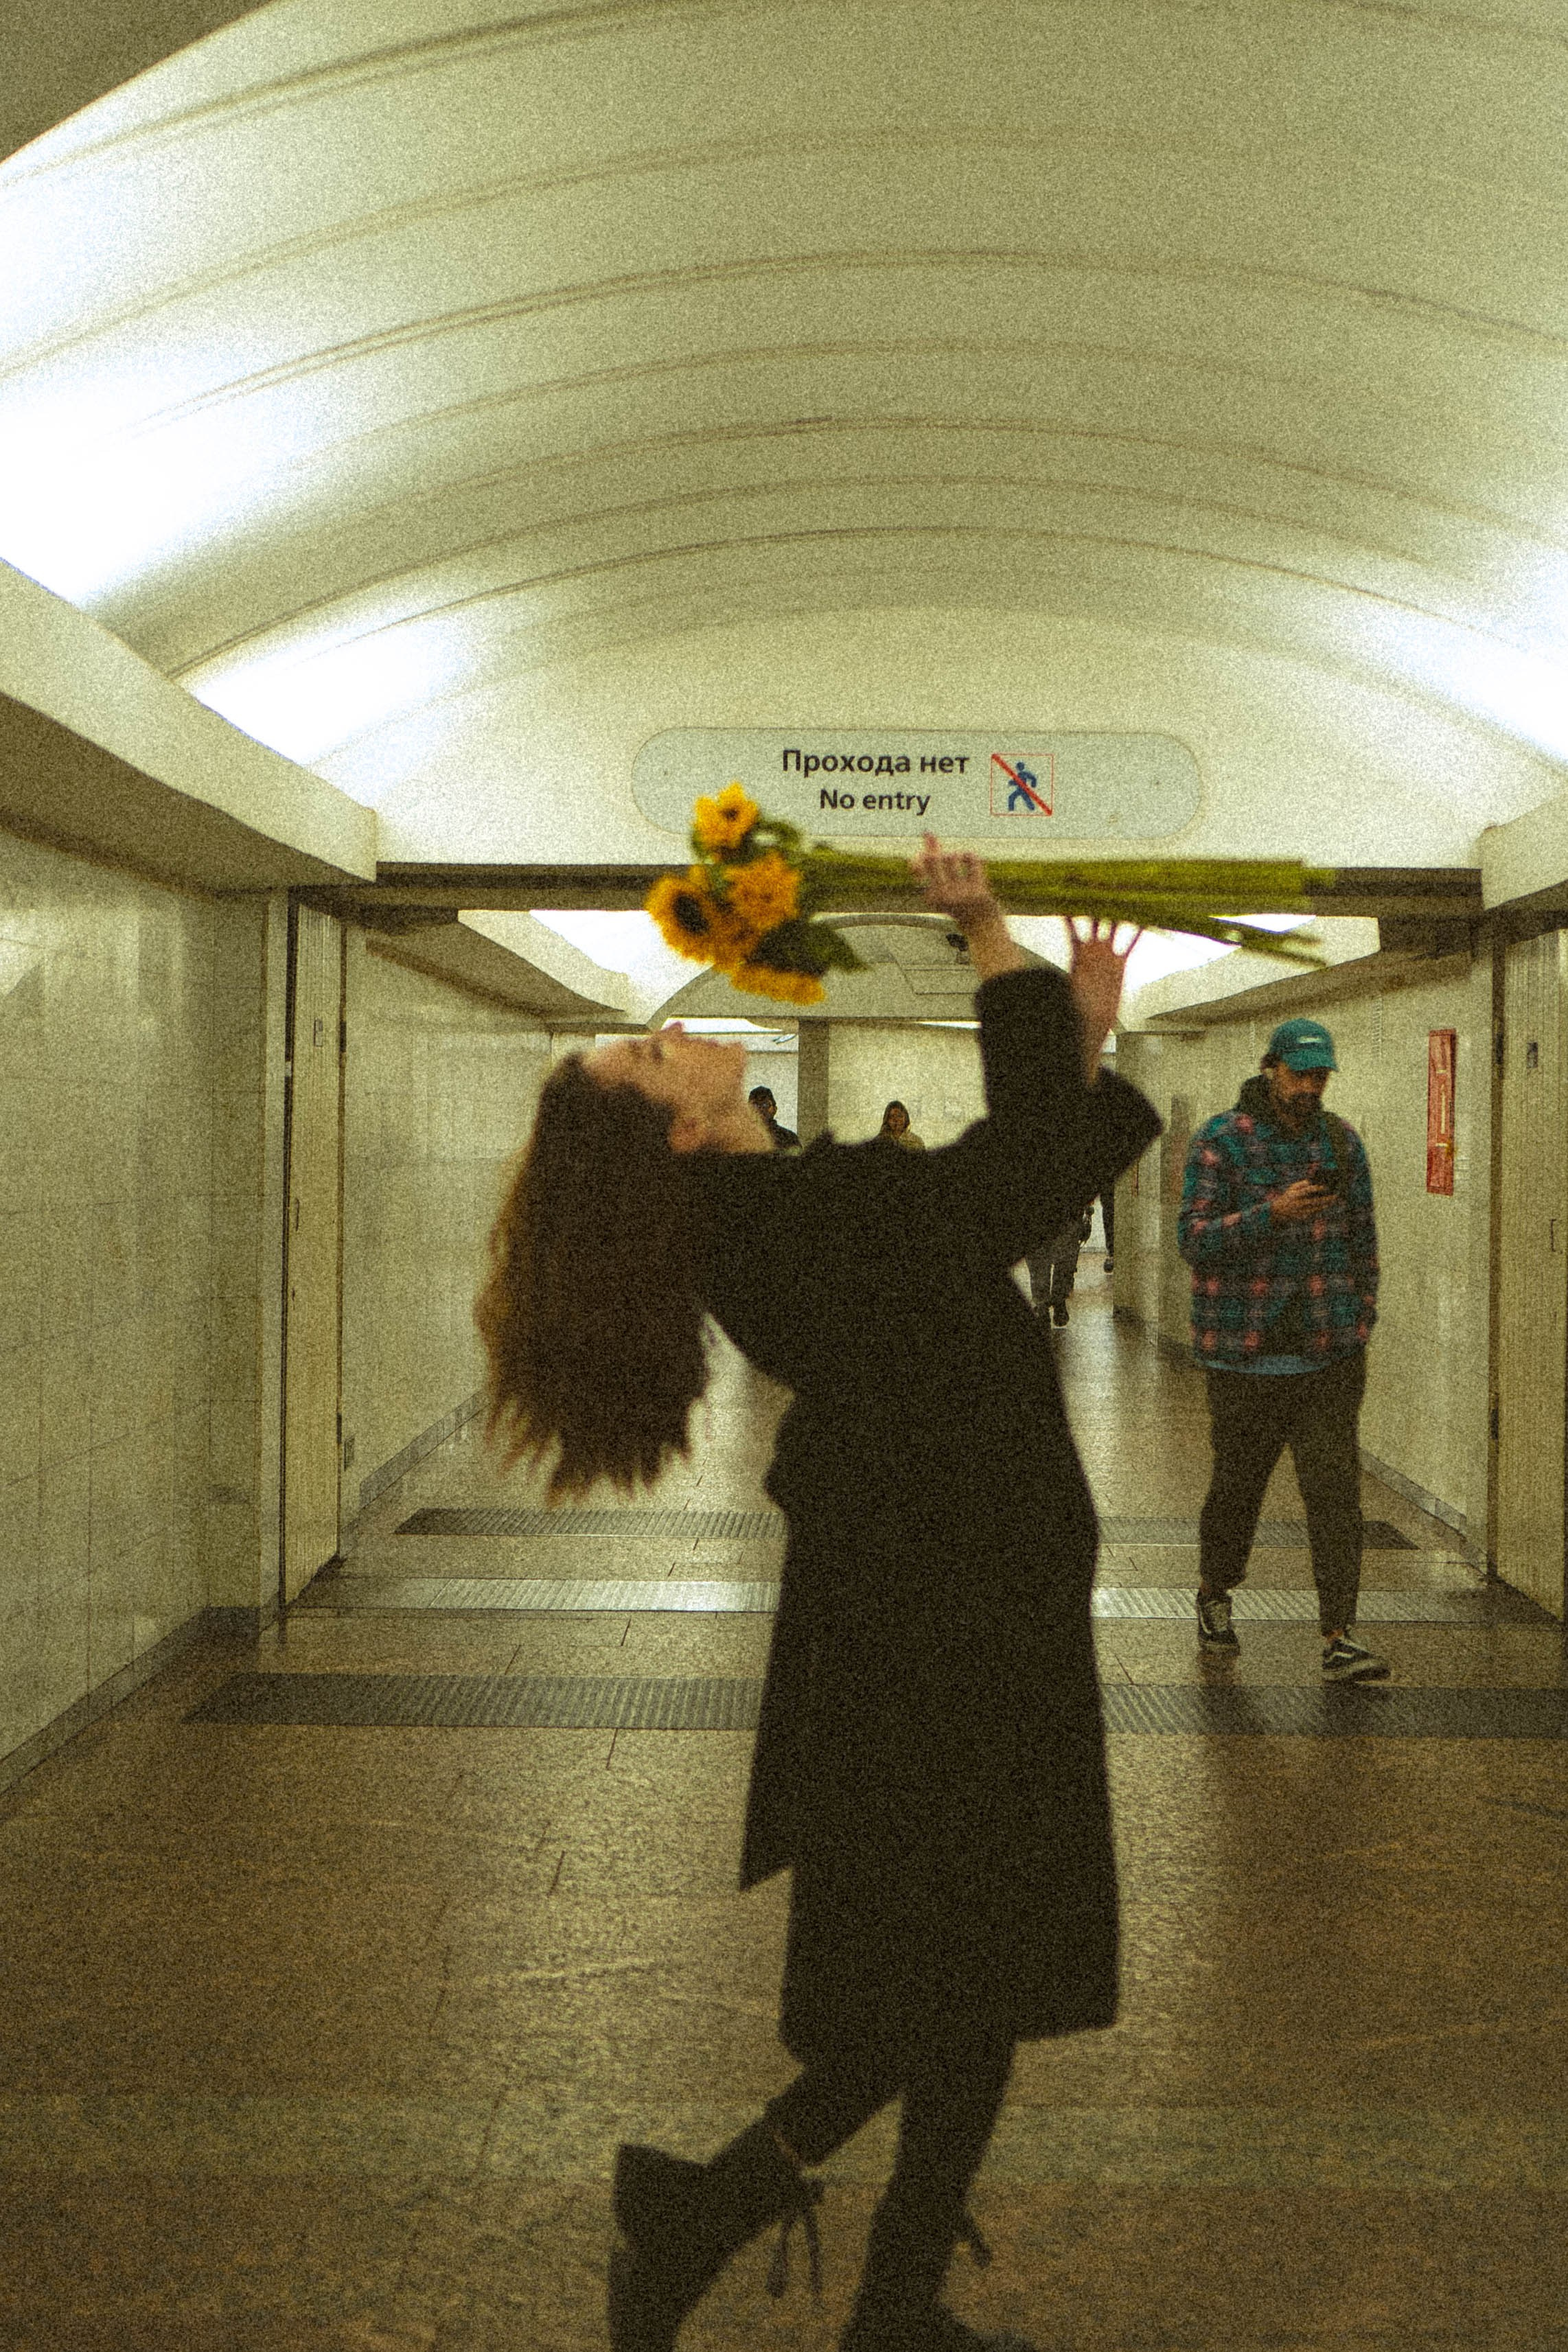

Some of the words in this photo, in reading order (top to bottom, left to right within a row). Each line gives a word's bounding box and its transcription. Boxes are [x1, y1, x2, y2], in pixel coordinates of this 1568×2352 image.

[783, 749, 911, 778] Прохода
[920, 755, 970, 774] нет
[820, 789, 855, 809] No
[862, 790, 931, 816] entry
